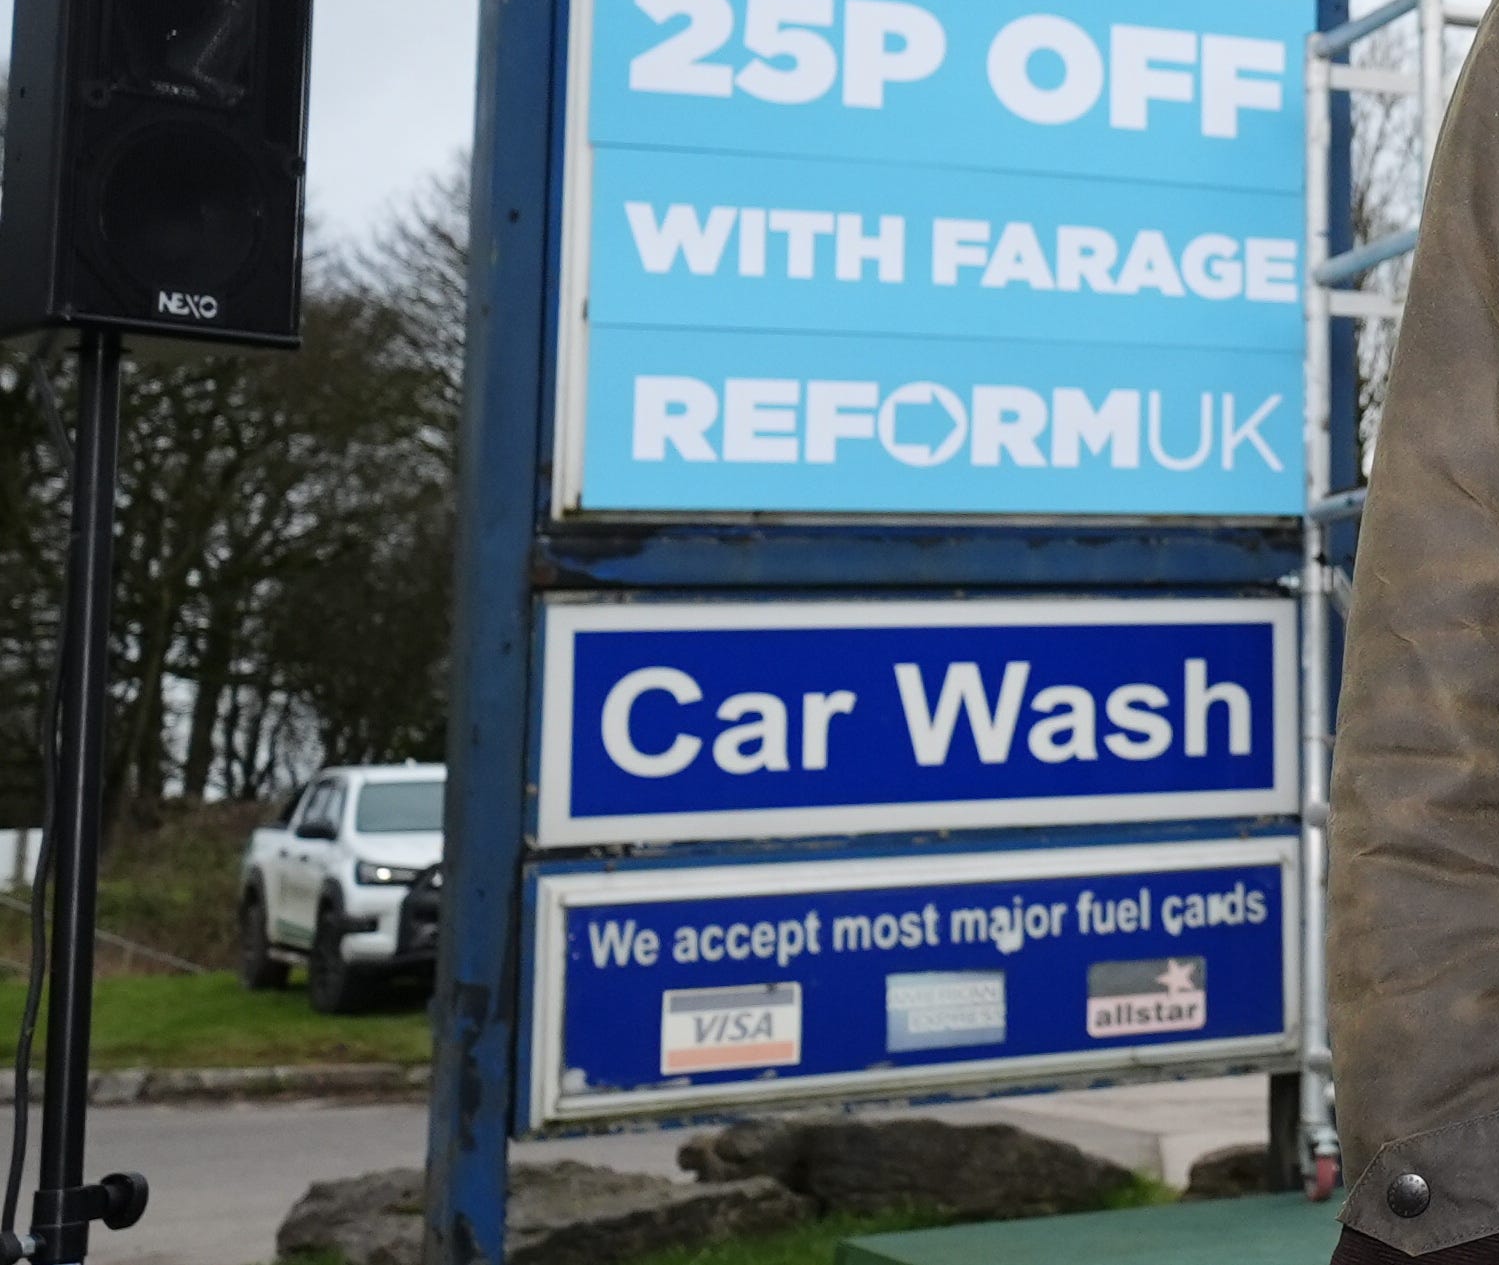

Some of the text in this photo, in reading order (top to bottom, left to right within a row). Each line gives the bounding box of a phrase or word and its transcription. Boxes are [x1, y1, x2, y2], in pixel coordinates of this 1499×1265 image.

[987, 14, 1285, 138] OFF
[624, 201, 1298, 303] WITH FARAGE
[159, 290, 218, 319] NEXO
[601, 658, 1252, 778] Car Wash
[588, 882, 1268, 969] We accept most major fuel cards
[693, 1011, 773, 1044] VISA
[1095, 1001, 1197, 1028] allstar
